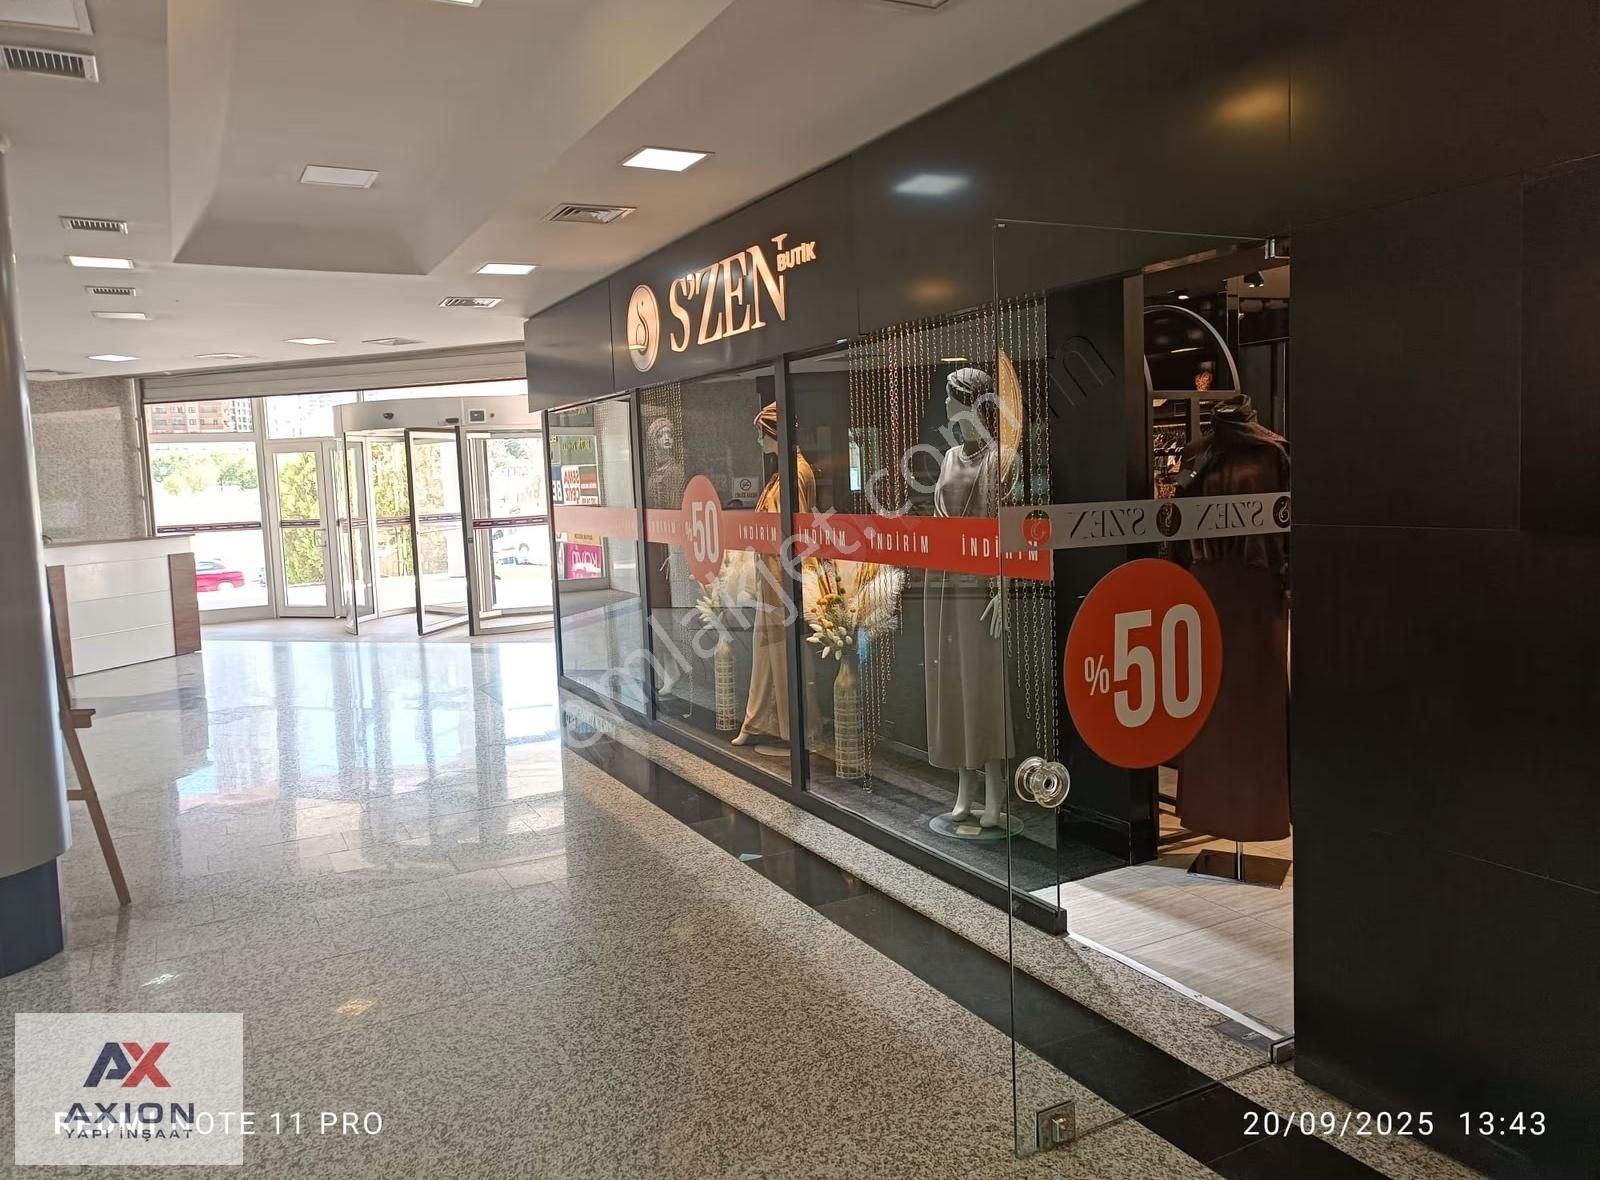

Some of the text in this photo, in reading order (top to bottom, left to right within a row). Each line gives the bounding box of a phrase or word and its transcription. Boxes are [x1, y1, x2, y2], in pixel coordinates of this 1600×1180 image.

[776, 241, 817, 272] BUTİK
[870, 529, 929, 553] İNDİRİM
[1084, 603, 1202, 728] %50
